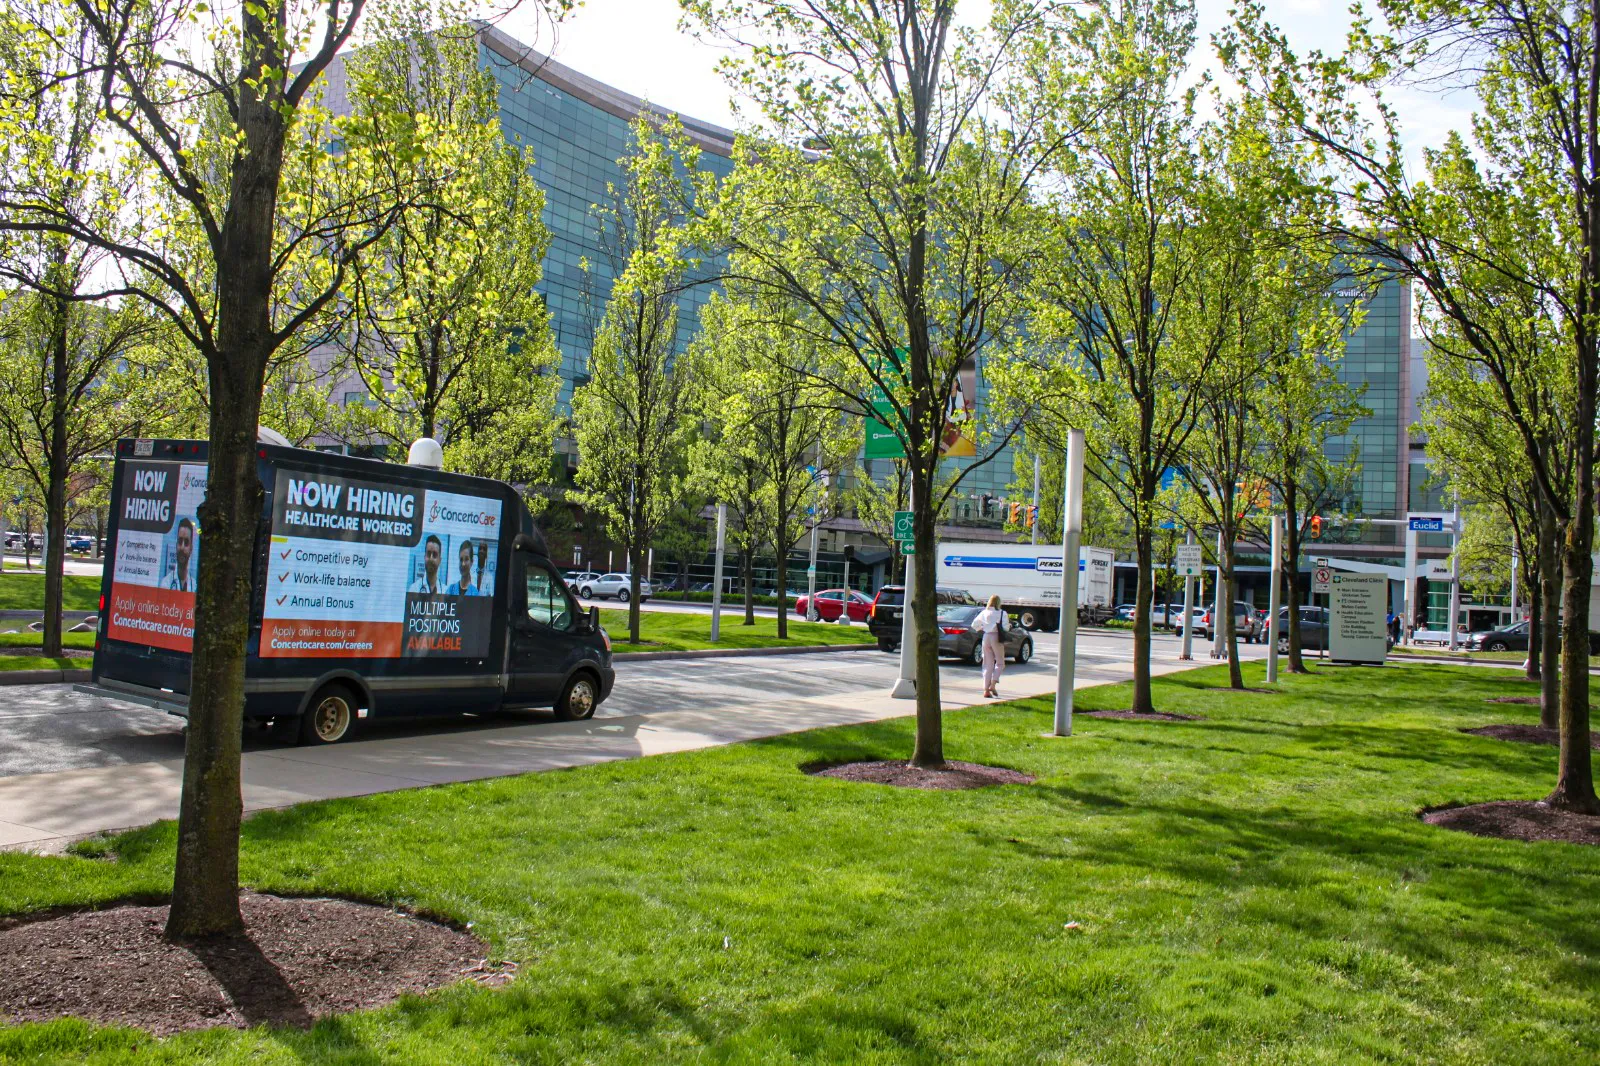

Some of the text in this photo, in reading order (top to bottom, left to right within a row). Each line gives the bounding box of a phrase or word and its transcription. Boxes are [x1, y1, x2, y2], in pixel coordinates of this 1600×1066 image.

[134, 470, 168, 492] NOW
[287, 479, 414, 518] NOW HIRING
[125, 498, 170, 522] HIRING
[441, 507, 496, 526] ConcertoCare
[285, 510, 413, 536] HEALTHCARE WORKERS
[296, 550, 368, 568] Competitive Pay
[1091, 559, 1109, 567] PENSKE
[294, 572, 371, 588] Work-life balance
[115, 596, 194, 621] Apply online today at
[291, 595, 354, 609] Annual Bonus
[410, 601, 456, 616] MULTIPLE
[113, 613, 194, 637] Concertocare.com/car
[272, 626, 355, 638] Apply online today at
[409, 618, 460, 633] POSITIONS
[271, 639, 373, 650] Concertocare.com/careers
[407, 636, 461, 650] AVAILABLE
